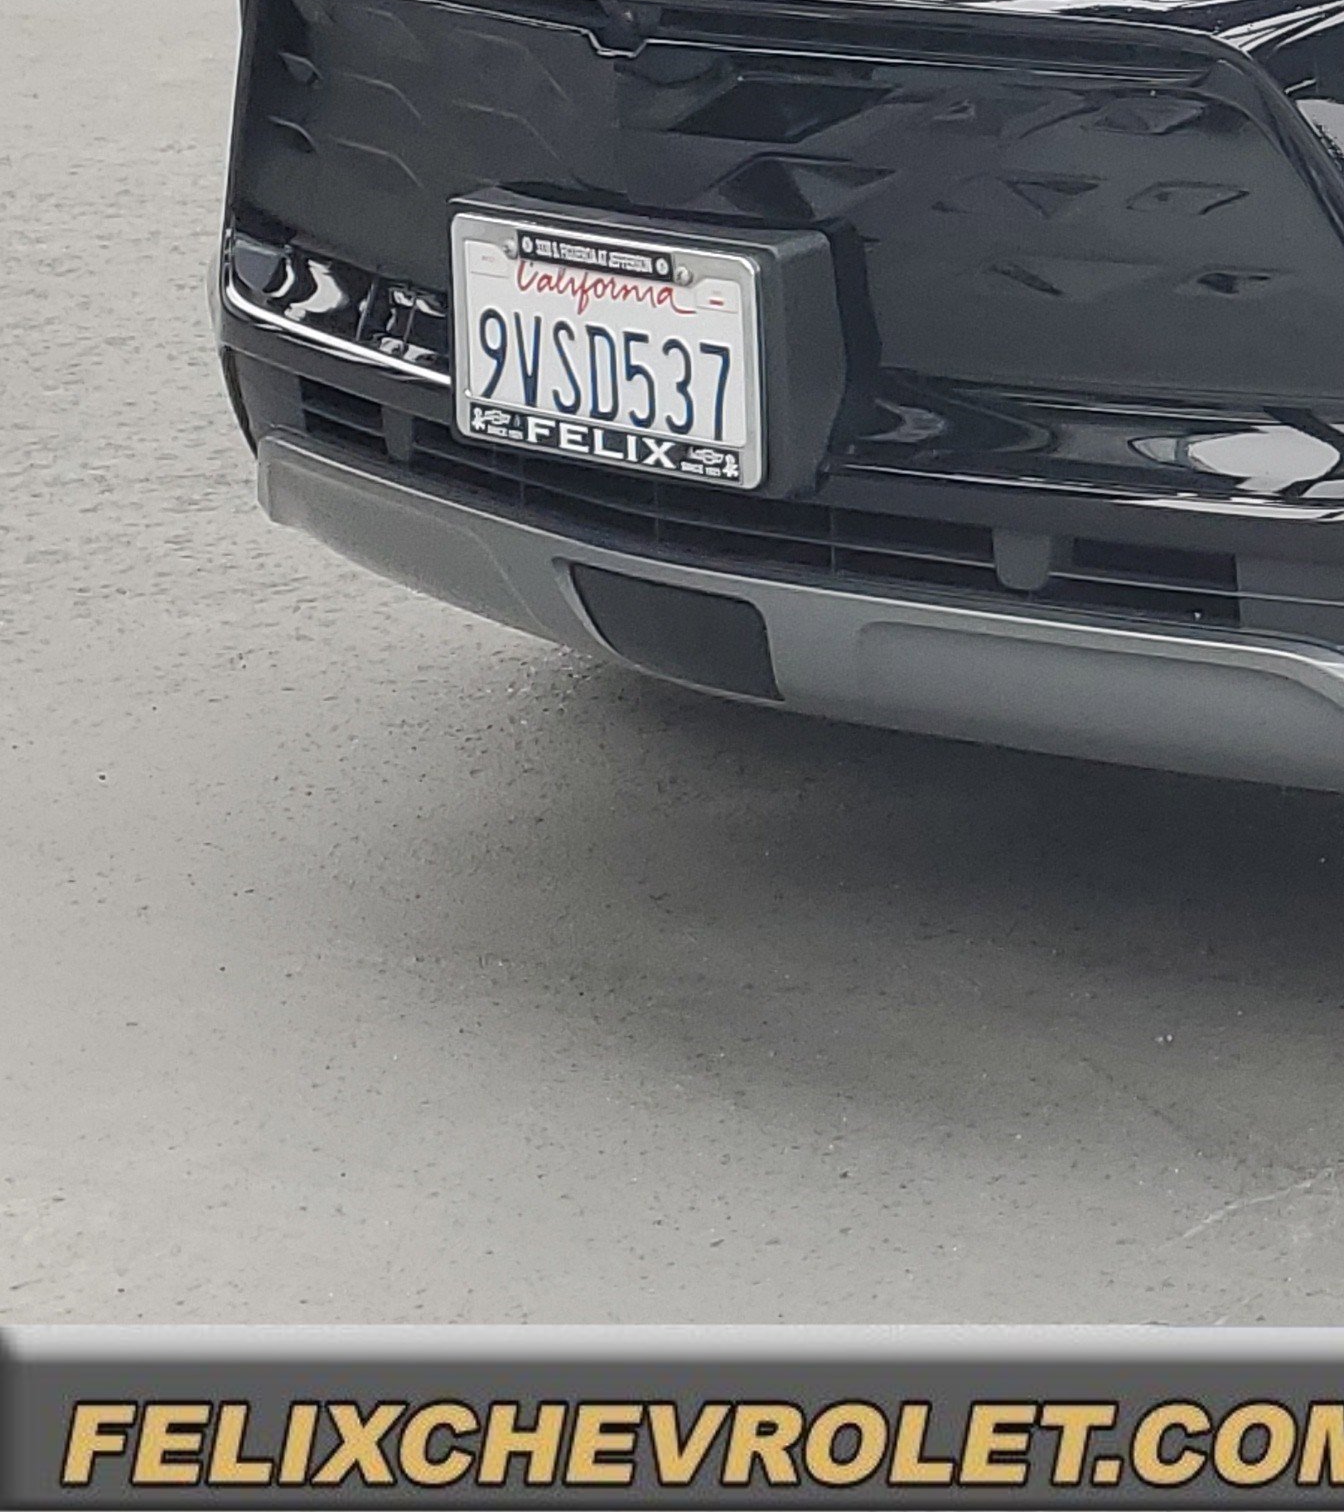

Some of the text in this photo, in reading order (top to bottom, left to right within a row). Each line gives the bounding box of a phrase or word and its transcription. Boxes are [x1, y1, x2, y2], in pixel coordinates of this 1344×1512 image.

[516, 259, 697, 315] California
[479, 307, 731, 442] 9VSD537
[526, 416, 677, 469] FELIX
